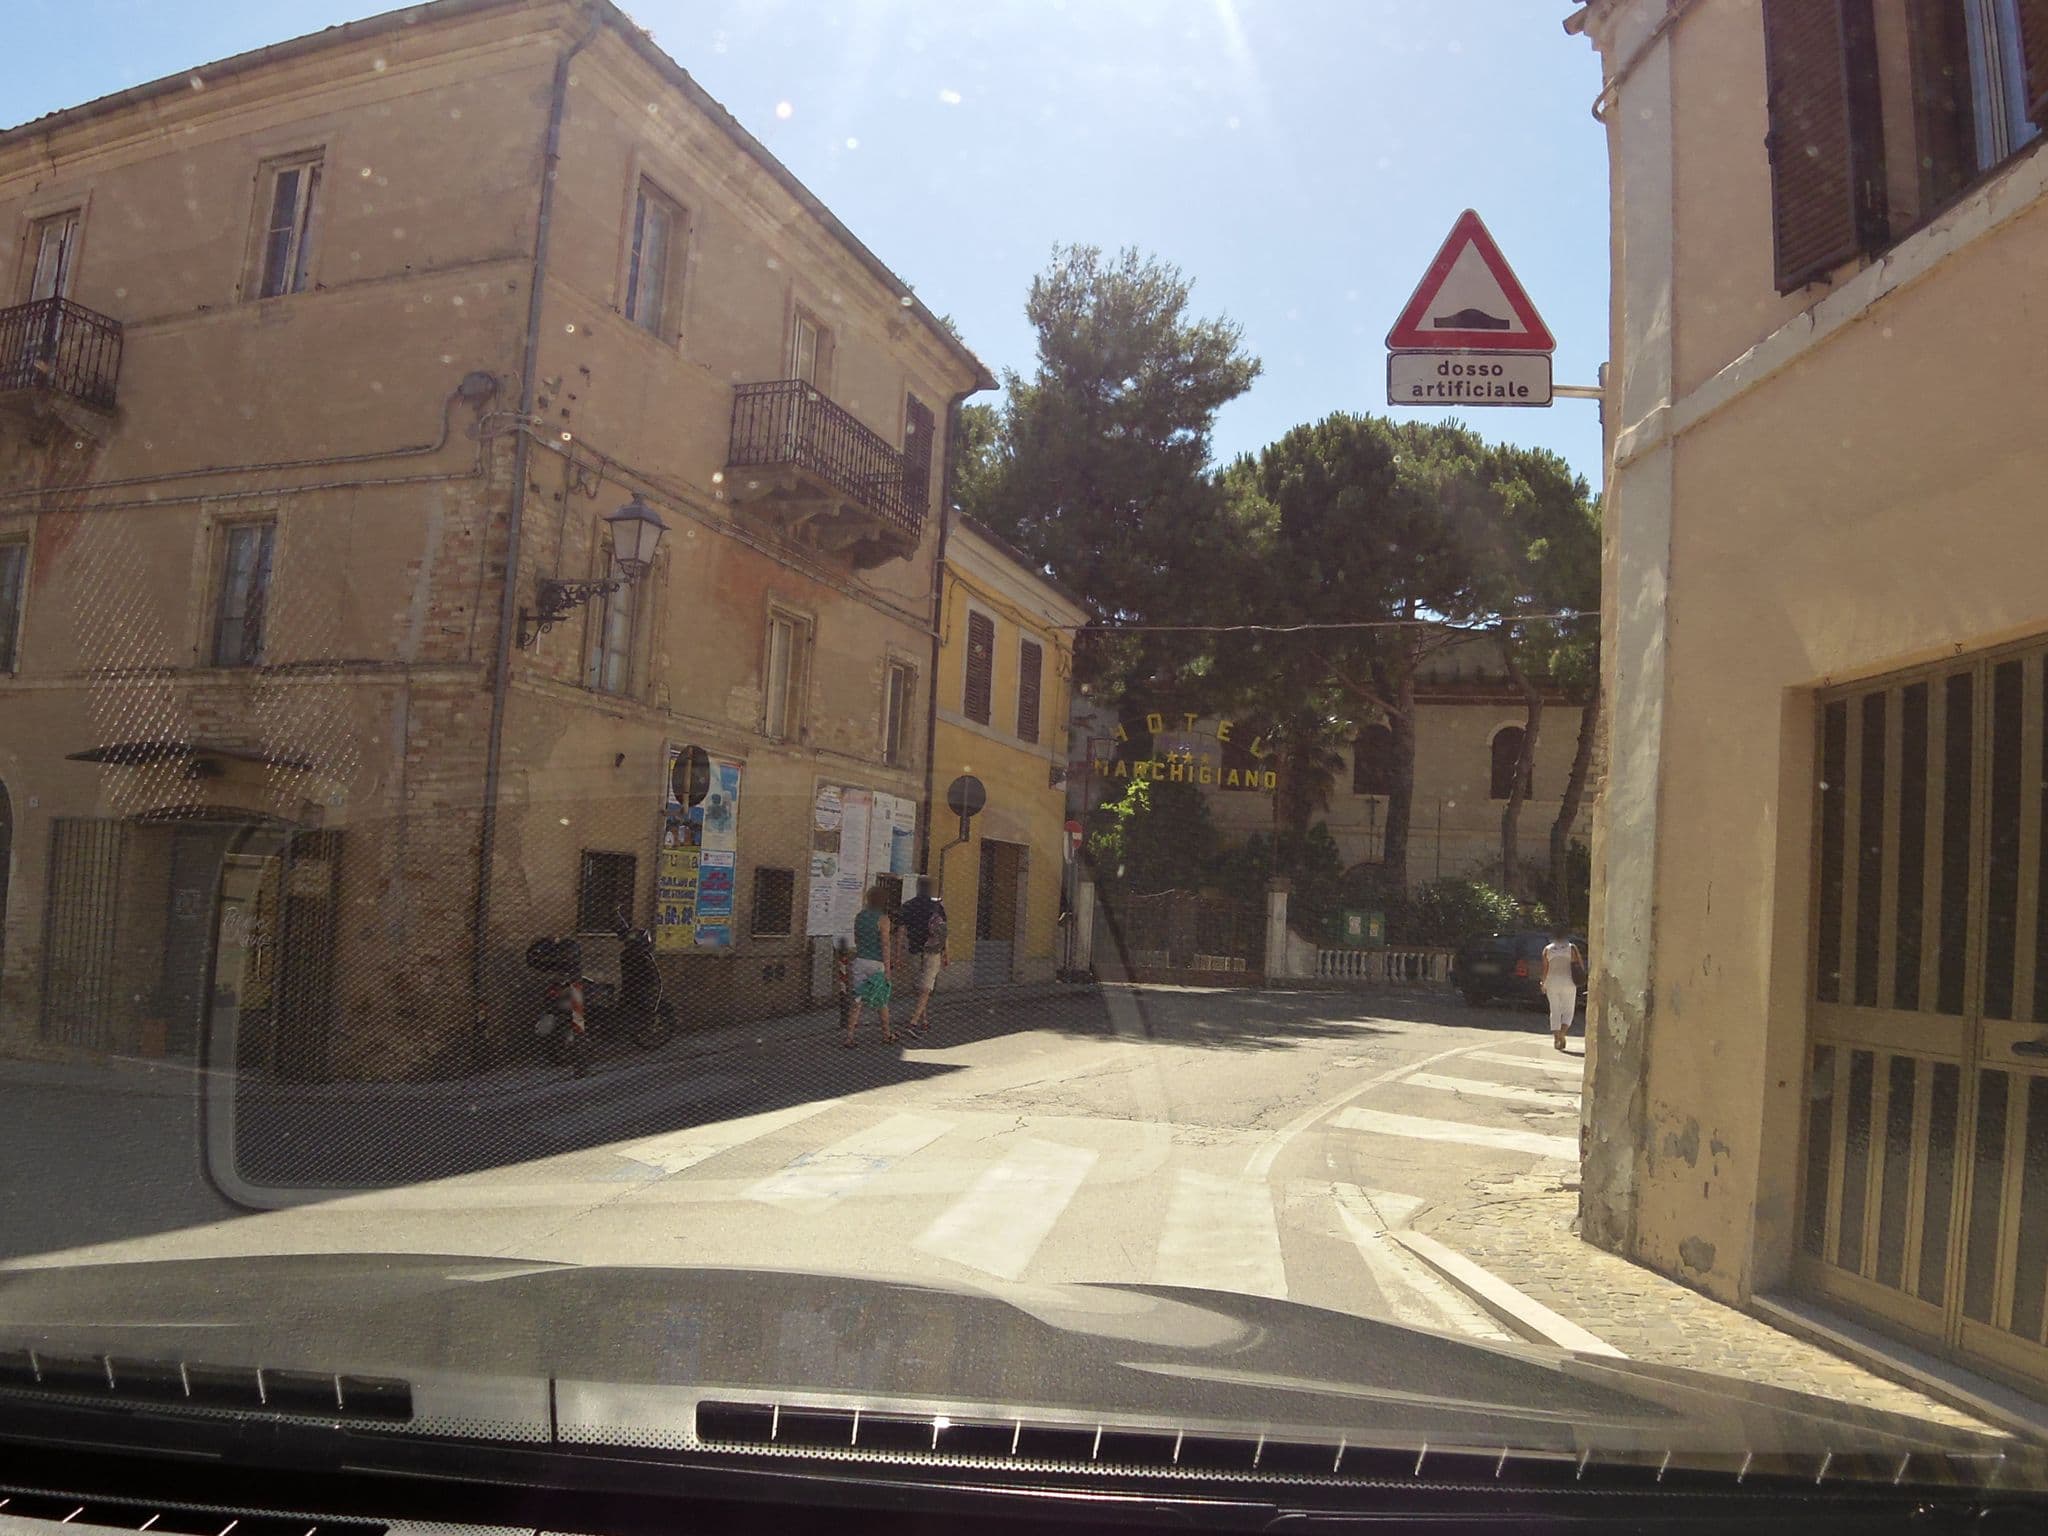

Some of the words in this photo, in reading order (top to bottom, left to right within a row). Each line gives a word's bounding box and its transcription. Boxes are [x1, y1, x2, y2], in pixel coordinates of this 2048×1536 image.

[1437, 360, 1503, 376] dosso
[1412, 381, 1529, 397] artificiale
[1093, 759, 1277, 789] MARCHIGIANO
